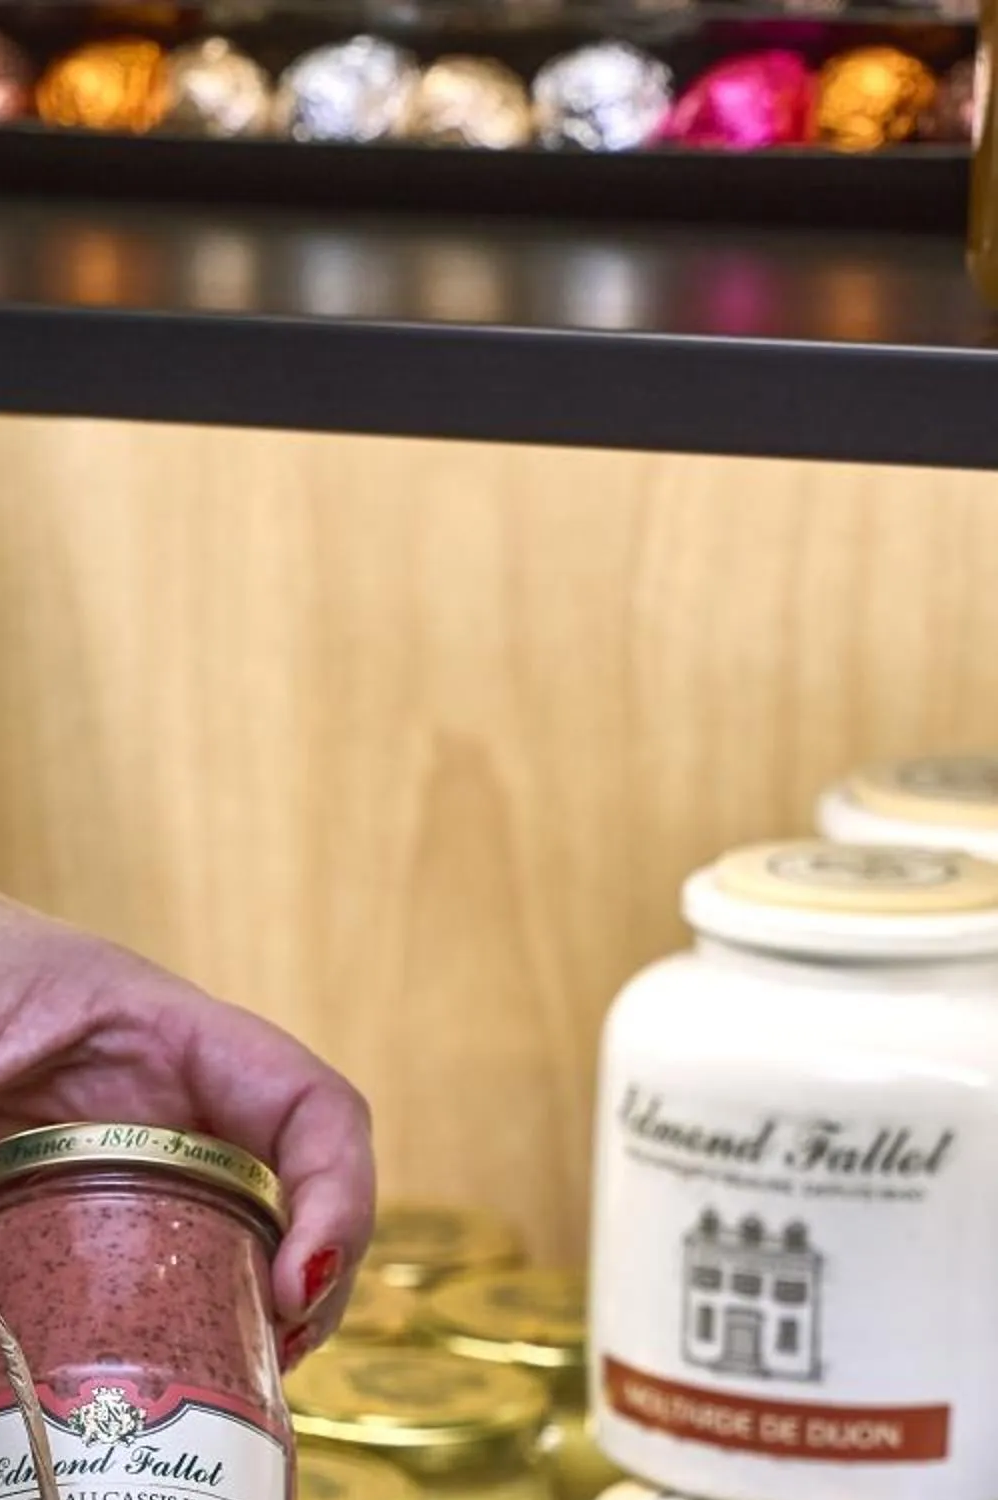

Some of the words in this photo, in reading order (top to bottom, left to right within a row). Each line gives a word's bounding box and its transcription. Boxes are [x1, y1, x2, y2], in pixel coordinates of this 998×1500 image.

[100, 1127, 150, 1149] 1840
[163, 1134, 234, 1170] France
[124, 1445, 225, 1487] Fallot
